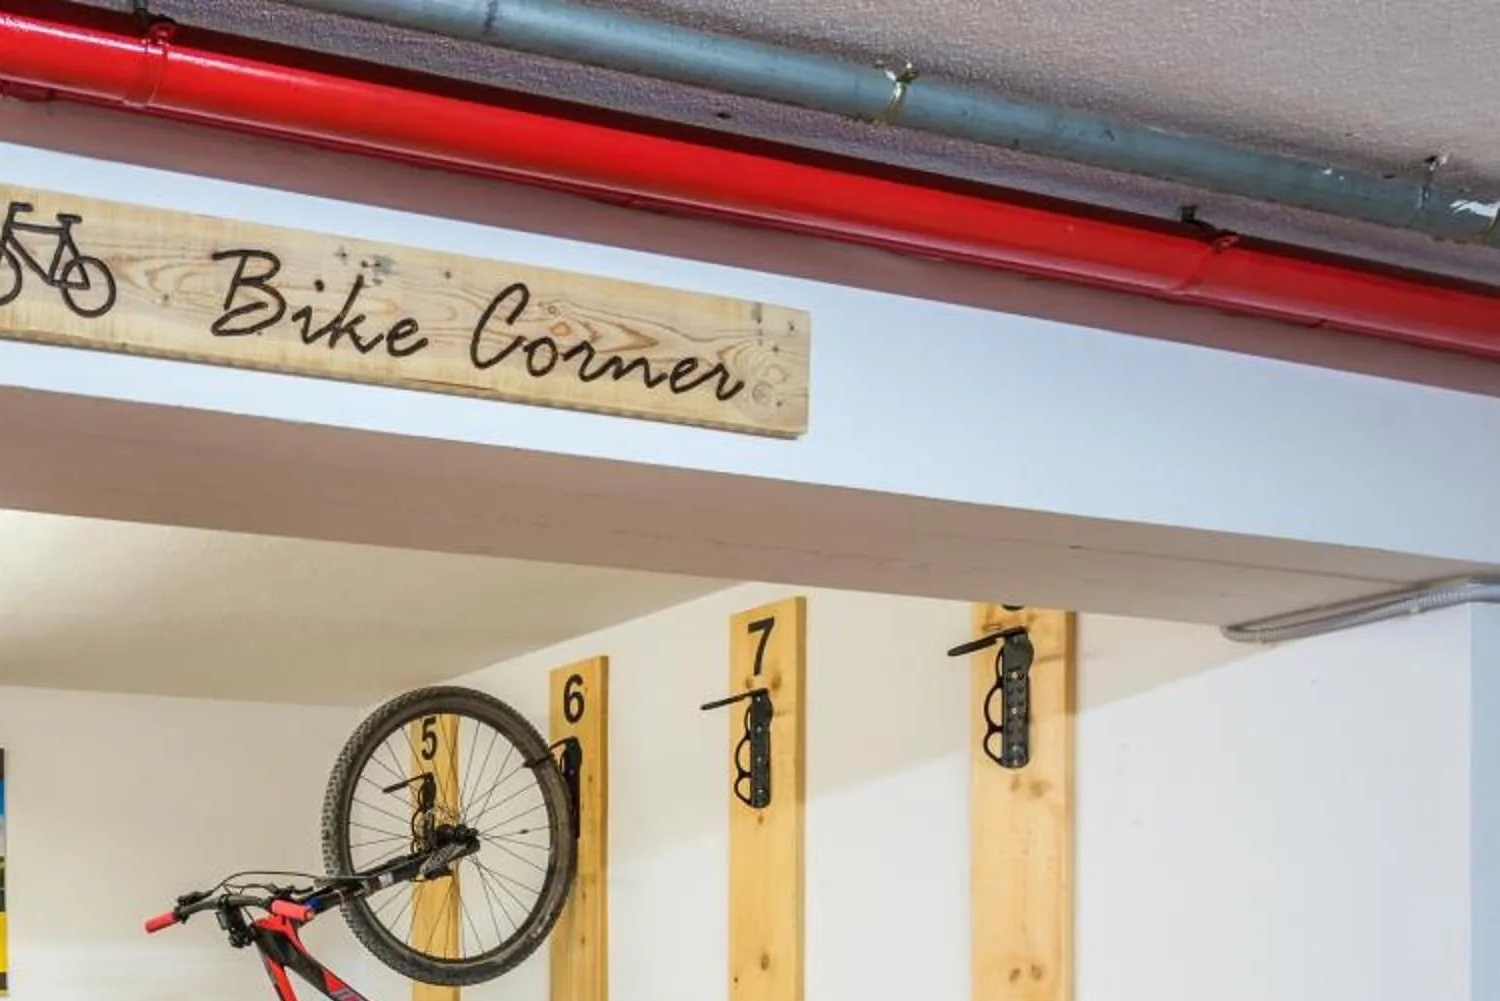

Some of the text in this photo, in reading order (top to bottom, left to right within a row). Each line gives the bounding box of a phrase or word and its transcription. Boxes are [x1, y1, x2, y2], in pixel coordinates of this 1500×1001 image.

[211, 248, 745, 402] Bike Corner
[747, 616, 775, 677] 7
[563, 673, 584, 723] 6
[421, 716, 437, 760] 5
